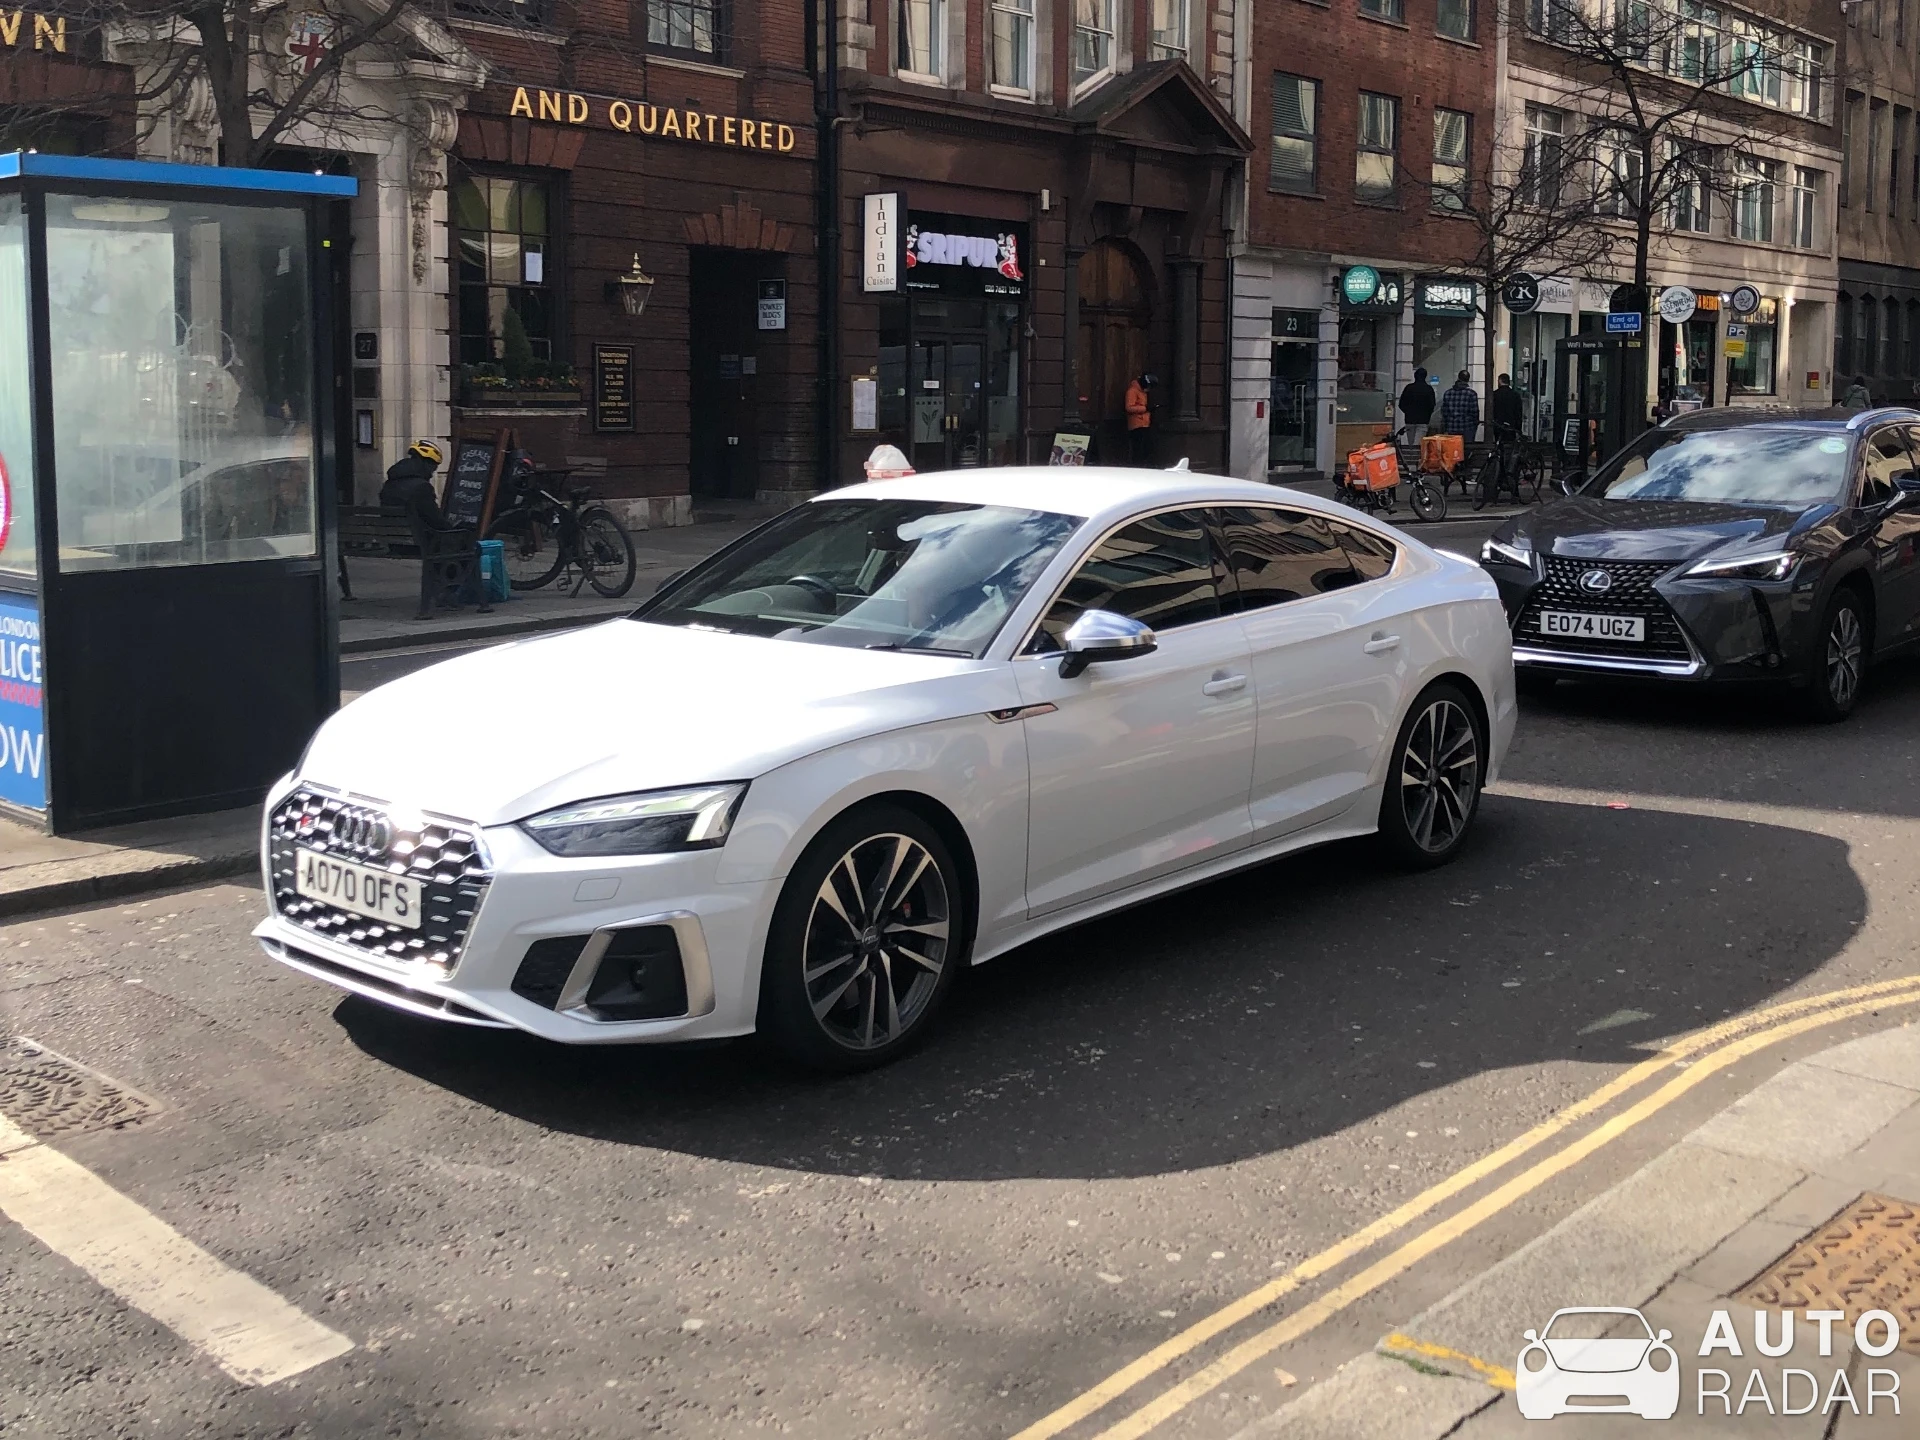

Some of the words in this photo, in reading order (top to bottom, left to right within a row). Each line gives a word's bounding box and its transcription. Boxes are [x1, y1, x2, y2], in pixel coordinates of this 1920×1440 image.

[510, 86, 588, 123] AND
[608, 101, 796, 152] QUARTERED
[875, 198, 887, 272] Indian
[917, 231, 998, 268] SRIPUR
[866, 276, 895, 286] Cuisine
[1286, 317, 1297, 331] 23
[1728, 326, 1737, 336] P
[360, 339, 371, 352] 27
[1599, 616, 1636, 638] UGZ
[363, 873, 409, 917] OFS
